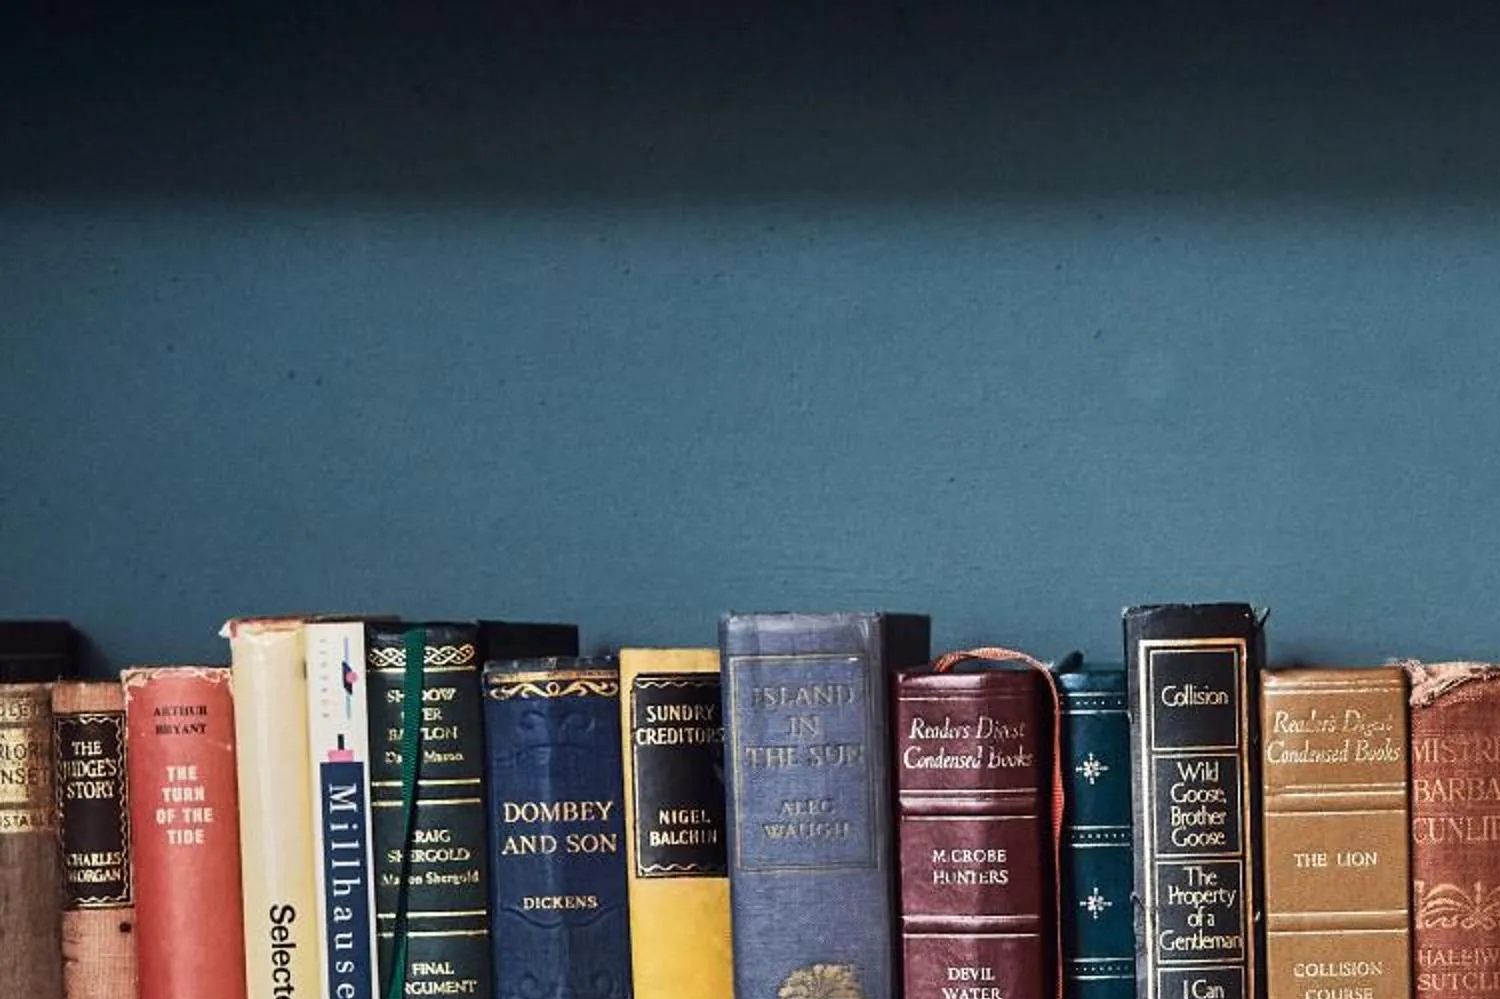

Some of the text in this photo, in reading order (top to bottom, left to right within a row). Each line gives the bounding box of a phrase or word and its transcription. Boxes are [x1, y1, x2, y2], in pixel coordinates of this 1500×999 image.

[753, 686, 854, 705] ISLAND
[1162, 685, 1229, 706] Collision
[154, 706, 208, 717] ARTHUR
[647, 704, 715, 722] SUNDRY
[155, 723, 207, 735] BRYANT
[786, 716, 819, 737] IN
[636, 728, 725, 745] CREDITORS
[72, 741, 102, 755] THE
[1267, 740, 1400, 763] Condensed Books
[746, 748, 802, 768] THE
[904, 747, 982, 769] Condensed
[166, 767, 198, 781] THE
[1177, 762, 1218, 782] Wild
[67, 781, 115, 798] STORY
[162, 788, 204, 801] TURN
[1171, 784, 1226, 803] Goose,
[156, 809, 214, 823] OF THE
[504, 802, 612, 823] DOMBEY
[659, 809, 710, 823] NIGEL
[1171, 807, 1227, 825] Brother
[168, 830, 205, 844] TIDE
[502, 834, 616, 854] AND SON
[650, 829, 717, 846] BALCHIN
[1172, 828, 1225, 846] Goose
[67, 853, 121, 866] CHARLES
[1294, 852, 1378, 867] THE LION
[933, 871, 1008, 884] HUNTERS
[1184, 867, 1217, 886] The
[524, 897, 598, 909] DICKENS
[1169, 886, 1236, 906] Property
[1187, 906, 1215, 926] of a
[1160, 931, 1243, 950] Gentleman
[412, 963, 454, 975] FINAL
[948, 968, 994, 980] DEVIL
[1294, 961, 1382, 977] COLLISION
[1184, 980, 1224, 999] I Can
